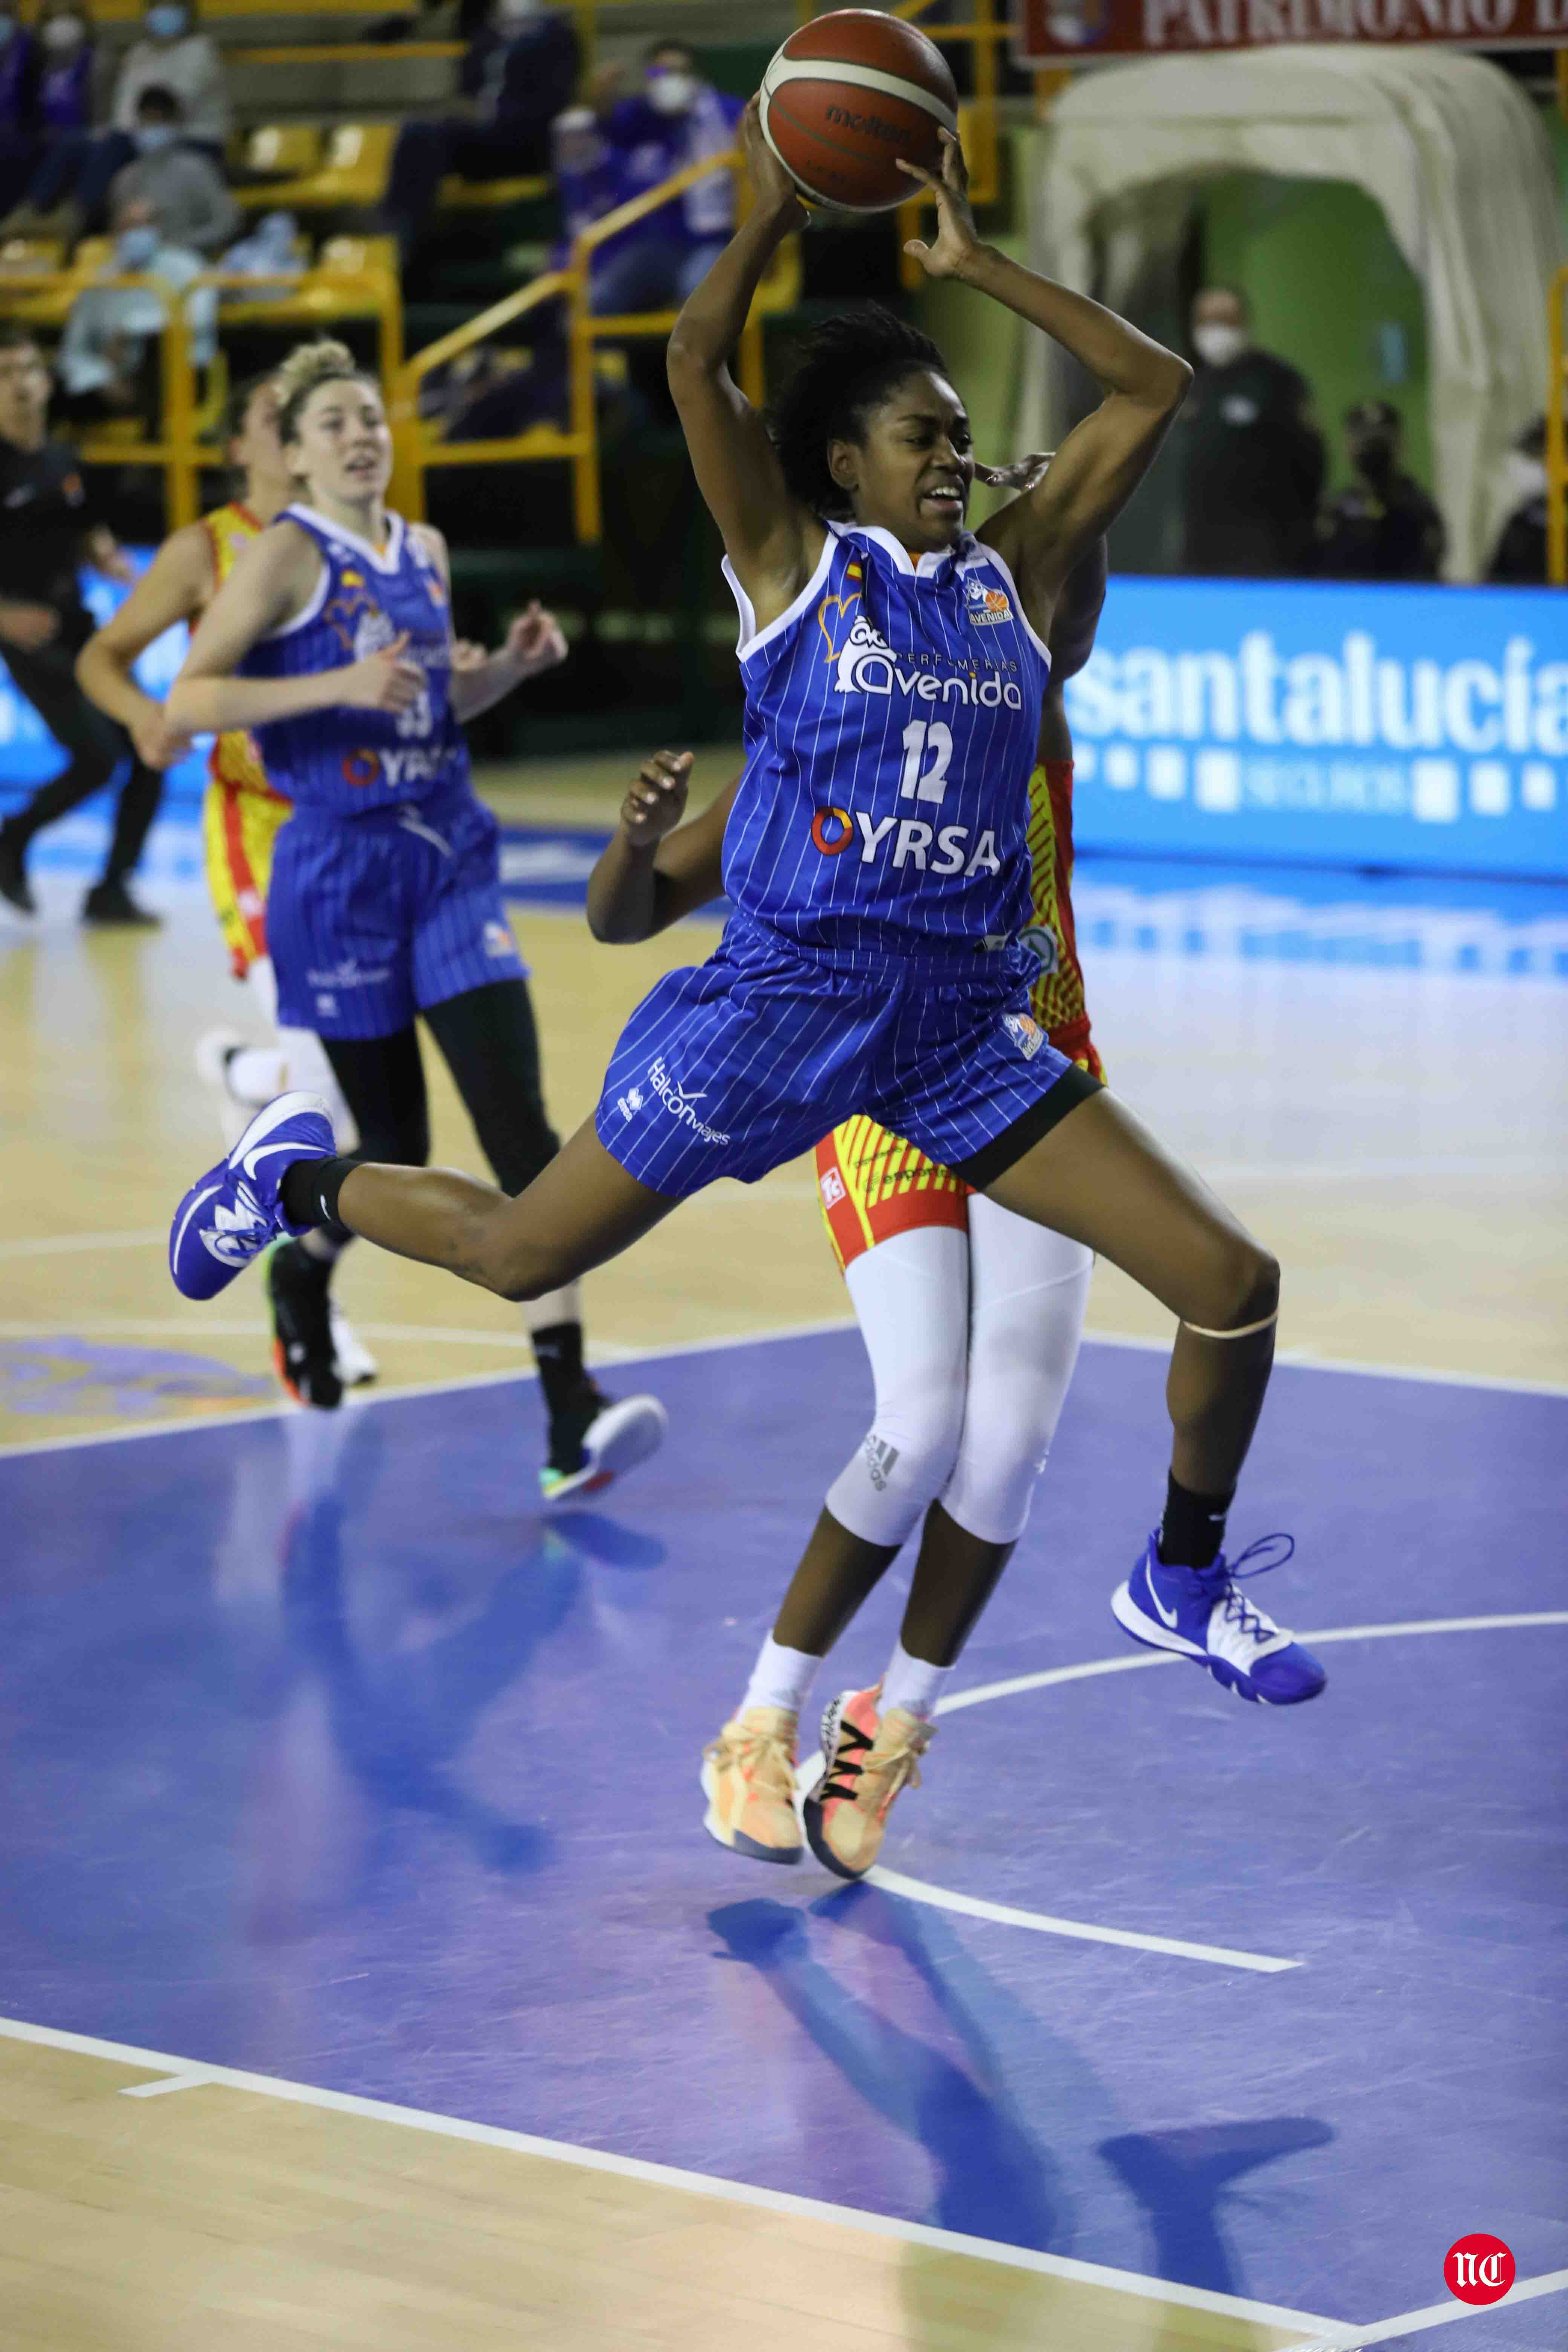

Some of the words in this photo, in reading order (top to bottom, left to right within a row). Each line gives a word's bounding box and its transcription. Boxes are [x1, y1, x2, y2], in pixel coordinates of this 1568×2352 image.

[969, 609, 1011, 623] AVENIDA
[901, 720, 953, 804] 12
[648, 1057, 695, 1125] Halcon
[692, 1119, 730, 1146] viajes
